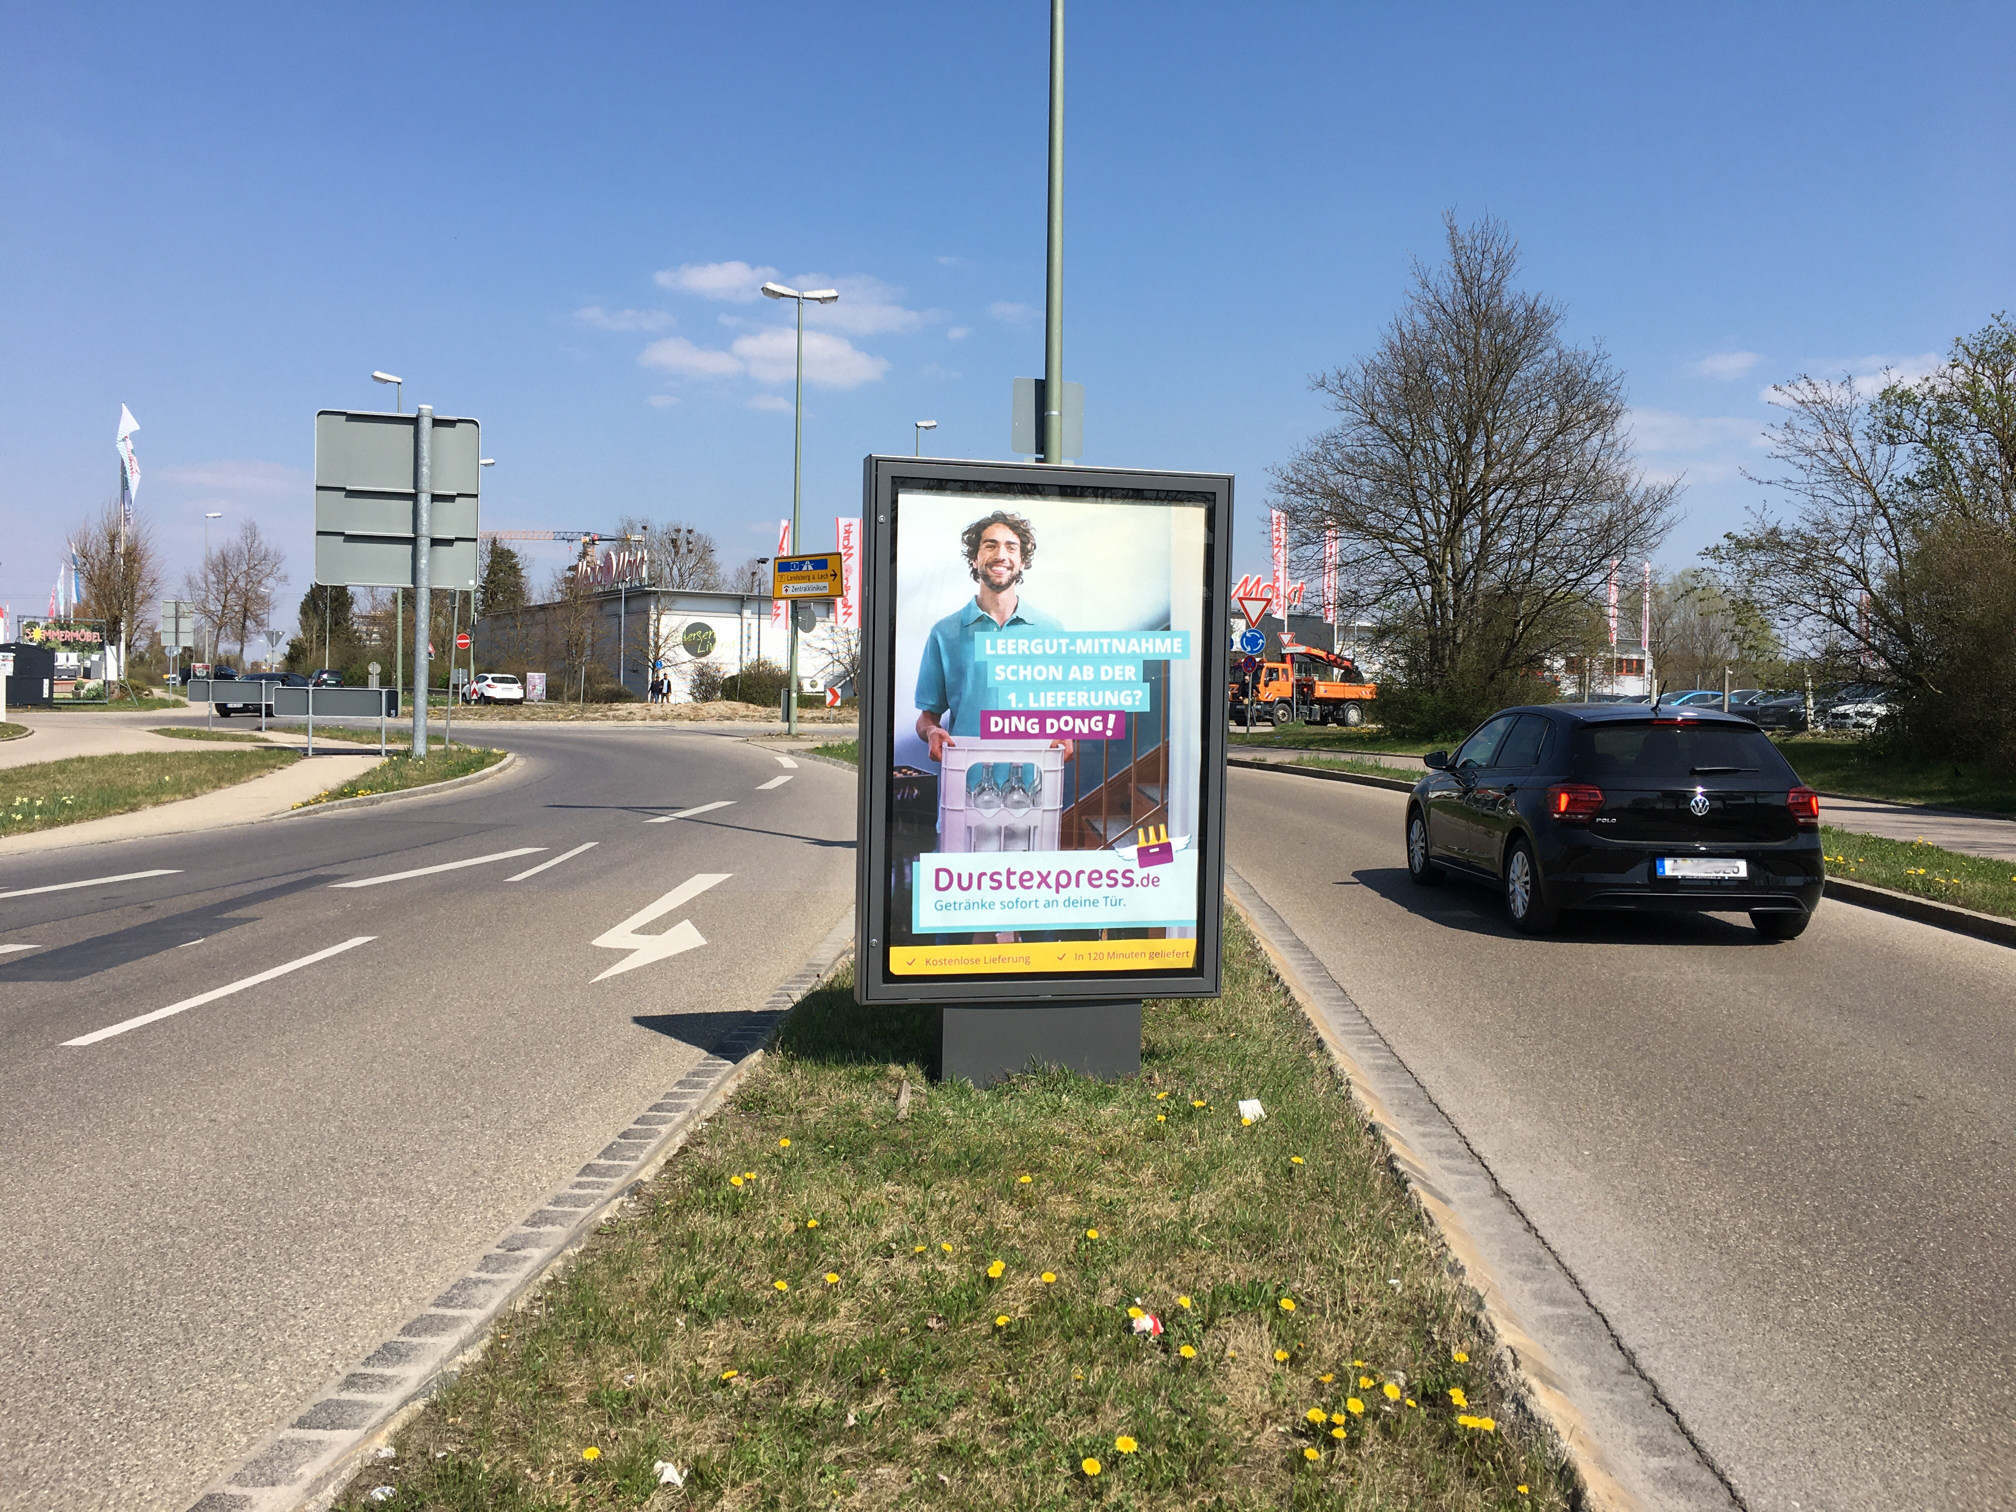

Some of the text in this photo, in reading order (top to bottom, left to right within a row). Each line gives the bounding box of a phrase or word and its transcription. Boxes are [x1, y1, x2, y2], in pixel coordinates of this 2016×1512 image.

[791, 584, 827, 593] Zentralklinikum
[1231, 574, 1306, 605] Makt
[985, 637, 1183, 655] LEERGUT-MITNAHME
[995, 665, 1137, 681] SCHON AB DER
[1007, 690, 1143, 708] 1. LIEFERUNG?
[990, 716, 1040, 735] DING
[934, 867, 1161, 895] Durstexpress.de
[934, 895, 1126, 912] Getränke sofort an deine Tür.
[925, 953, 1031, 967] Kostenlose Lieferung
[1074, 949, 1189, 961] In 120 Minuten geliefert
